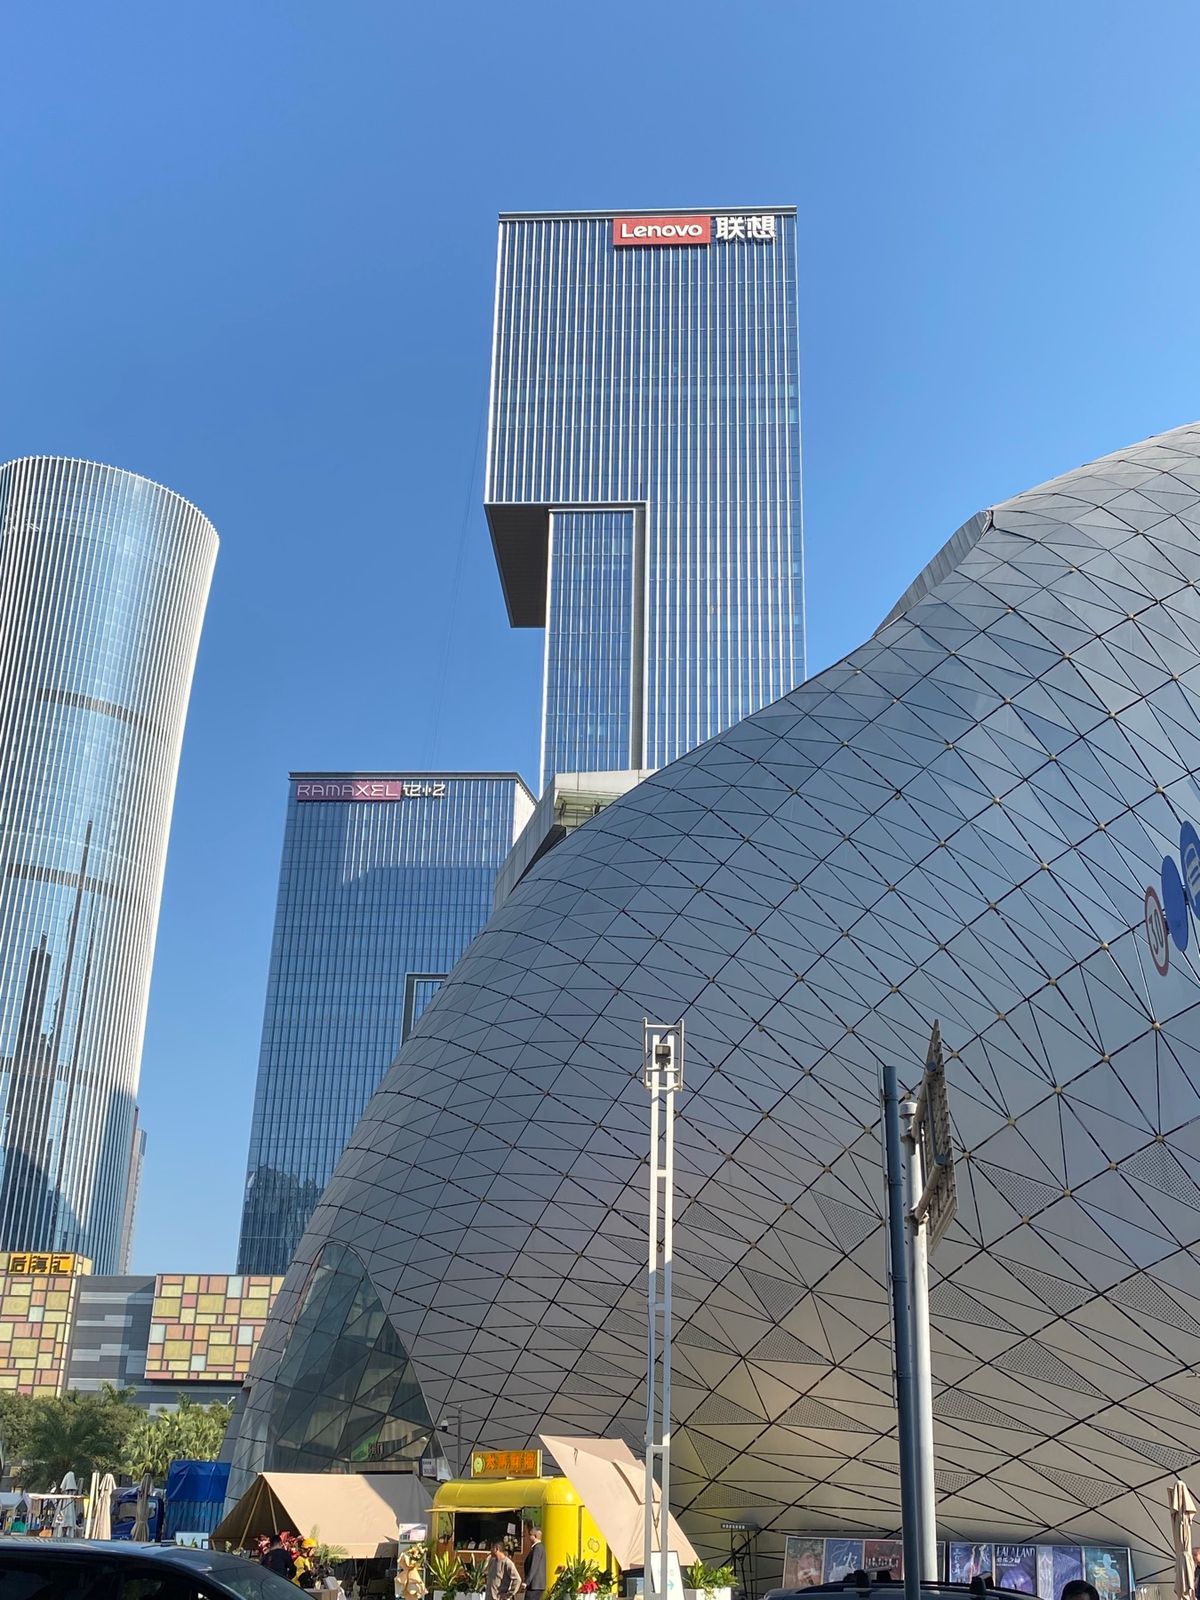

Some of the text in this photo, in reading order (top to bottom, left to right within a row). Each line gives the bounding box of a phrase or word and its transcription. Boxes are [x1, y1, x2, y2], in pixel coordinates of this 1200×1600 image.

[620, 222, 703, 239] Lenovo
[715, 215, 776, 240] 联想
[297, 784, 398, 797] RAMAXEL
[10, 1255, 71, 1273] 后海汇
